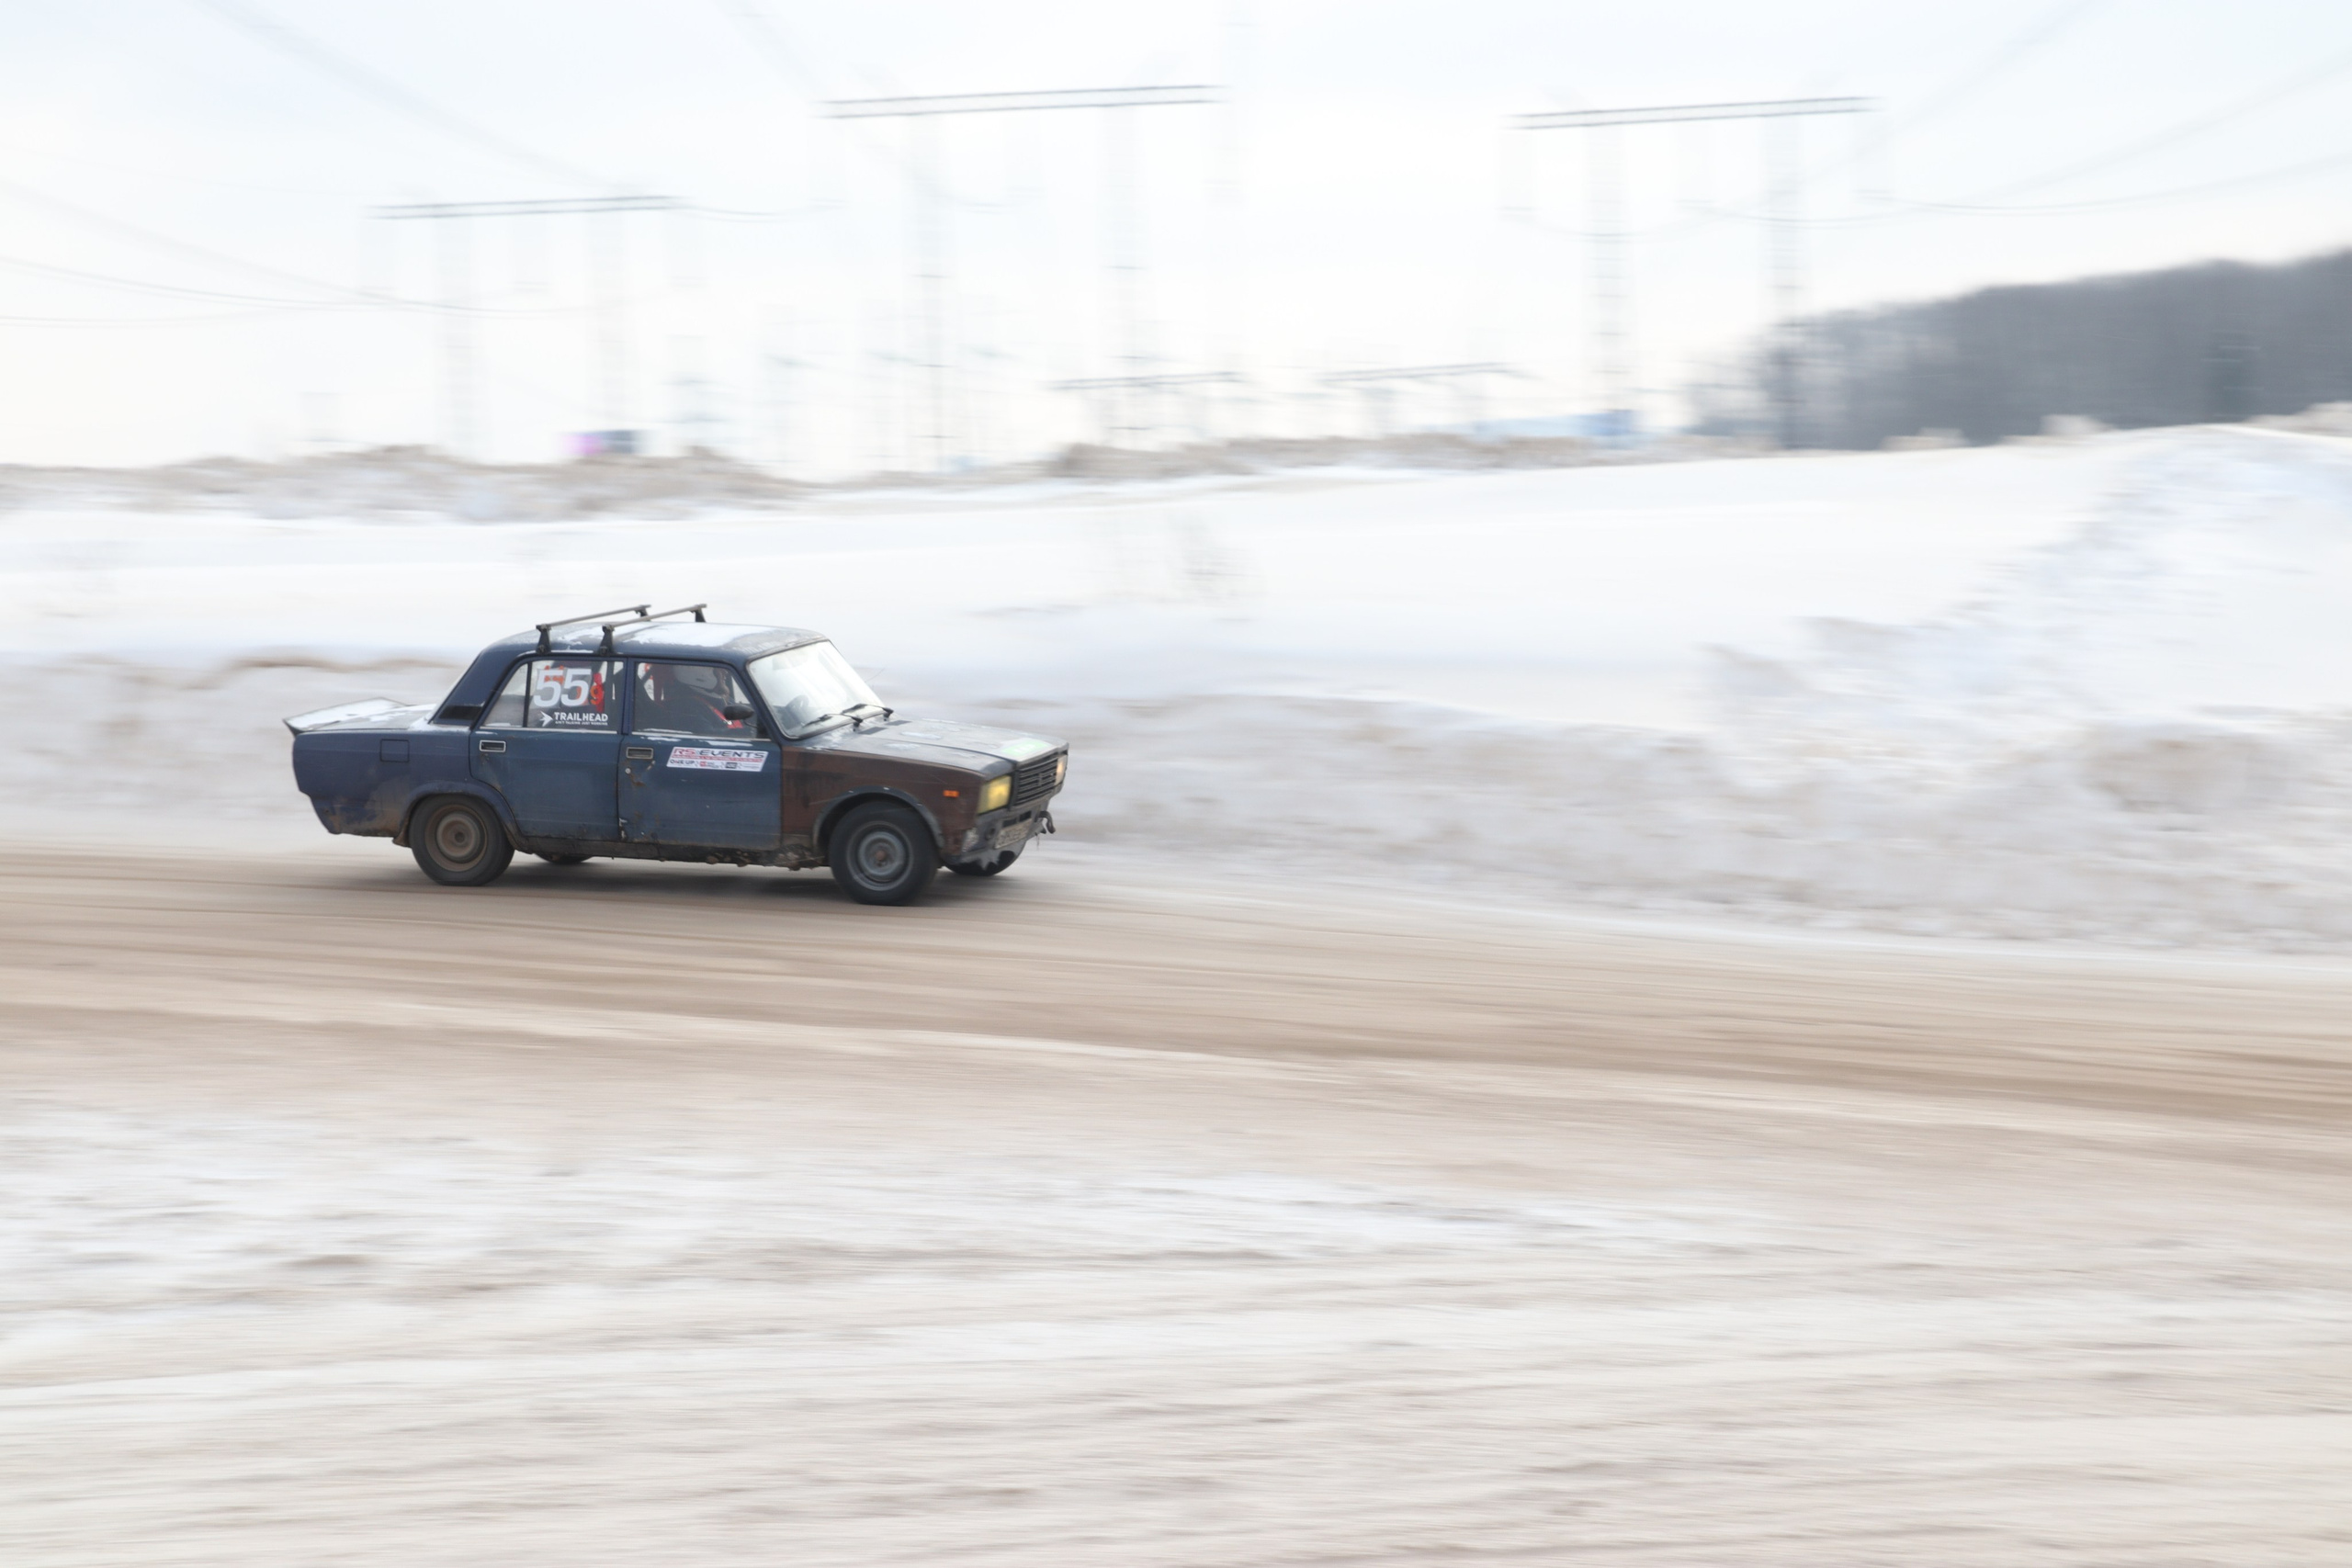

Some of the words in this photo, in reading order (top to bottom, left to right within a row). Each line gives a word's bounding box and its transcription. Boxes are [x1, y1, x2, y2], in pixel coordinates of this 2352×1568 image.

[533, 669, 592, 707] 55
[554, 712, 608, 722] TRAILHEAD
[699, 750, 764, 758] EVENTS
